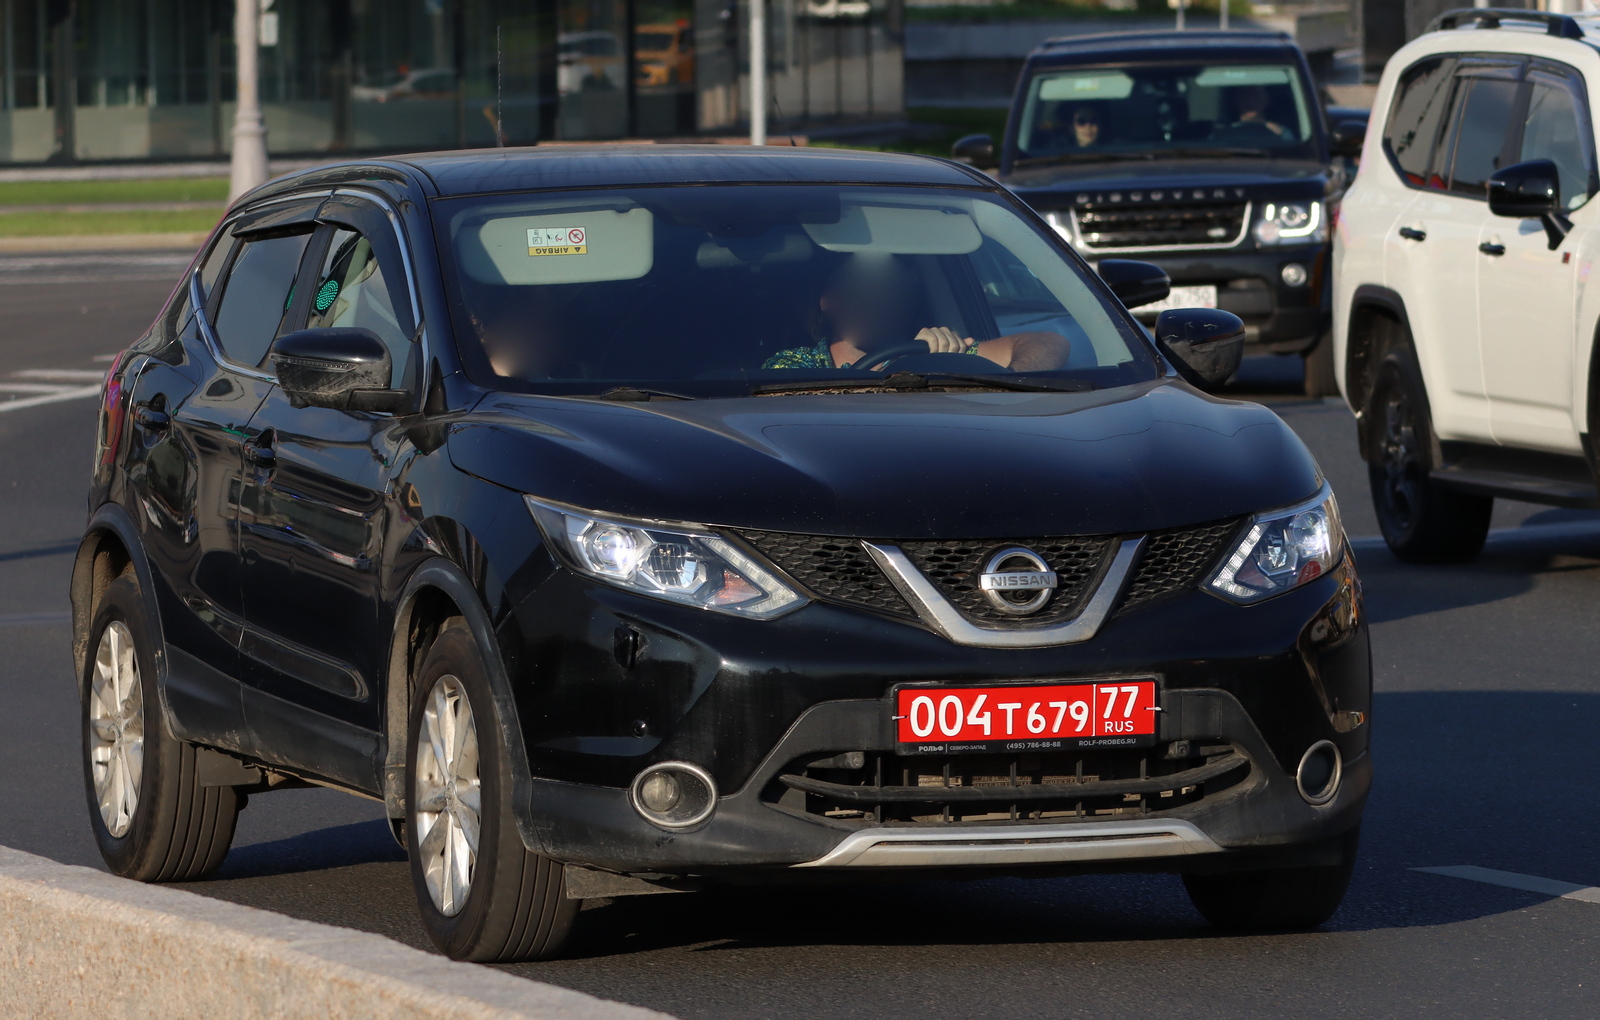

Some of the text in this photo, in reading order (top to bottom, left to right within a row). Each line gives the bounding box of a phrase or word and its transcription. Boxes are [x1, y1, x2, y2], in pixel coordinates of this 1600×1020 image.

[1076, 189, 1244, 203] DISCOVERY
[990, 576, 1051, 586] NISSAN
[1099, 686, 1139, 719] 77
[1104, 720, 1135, 733] RUS
[1006, 741, 1061, 750] (495) 786-88-88
[1078, 738, 1137, 747] ROLF-PROBEG.RU
